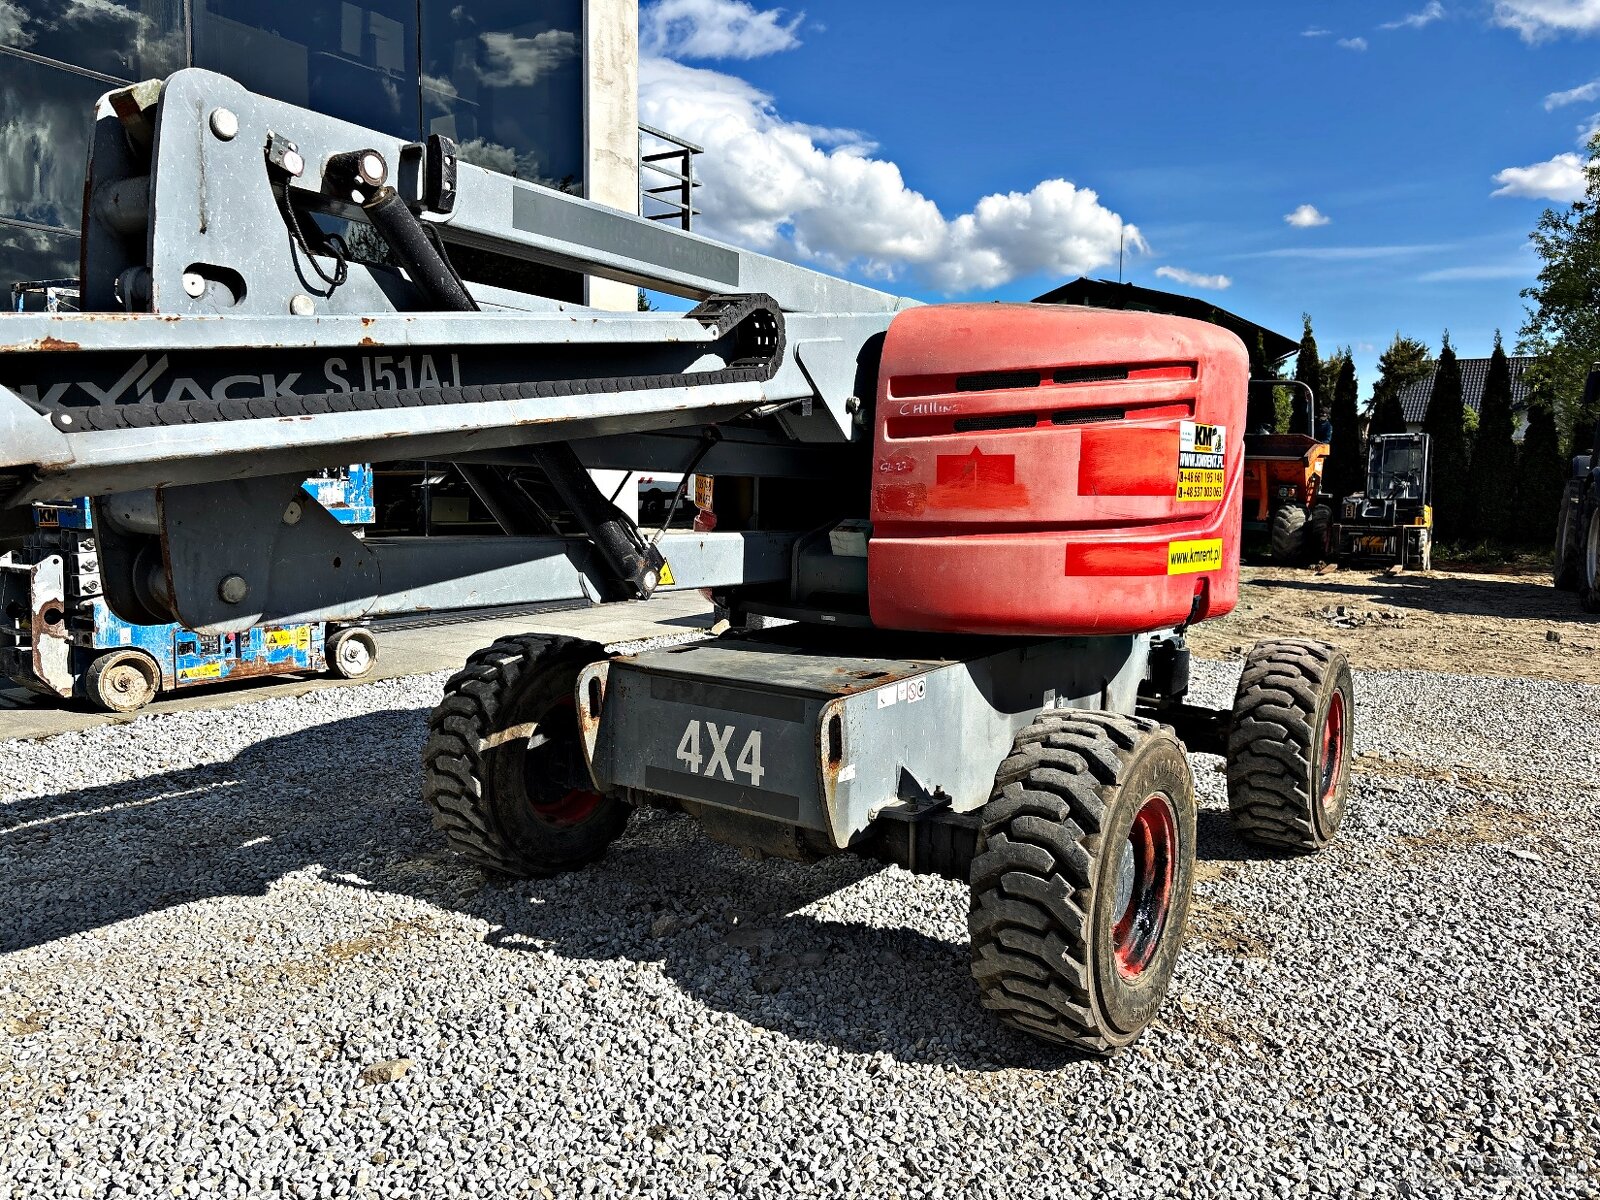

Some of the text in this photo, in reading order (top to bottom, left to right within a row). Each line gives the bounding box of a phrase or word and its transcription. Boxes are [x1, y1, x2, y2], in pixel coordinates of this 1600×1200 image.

[1195, 426, 1212, 446] KM
[39, 508, 58, 522] KM
[1171, 546, 1221, 565] www.kmrent.pl
[676, 719, 765, 786] 4X4
